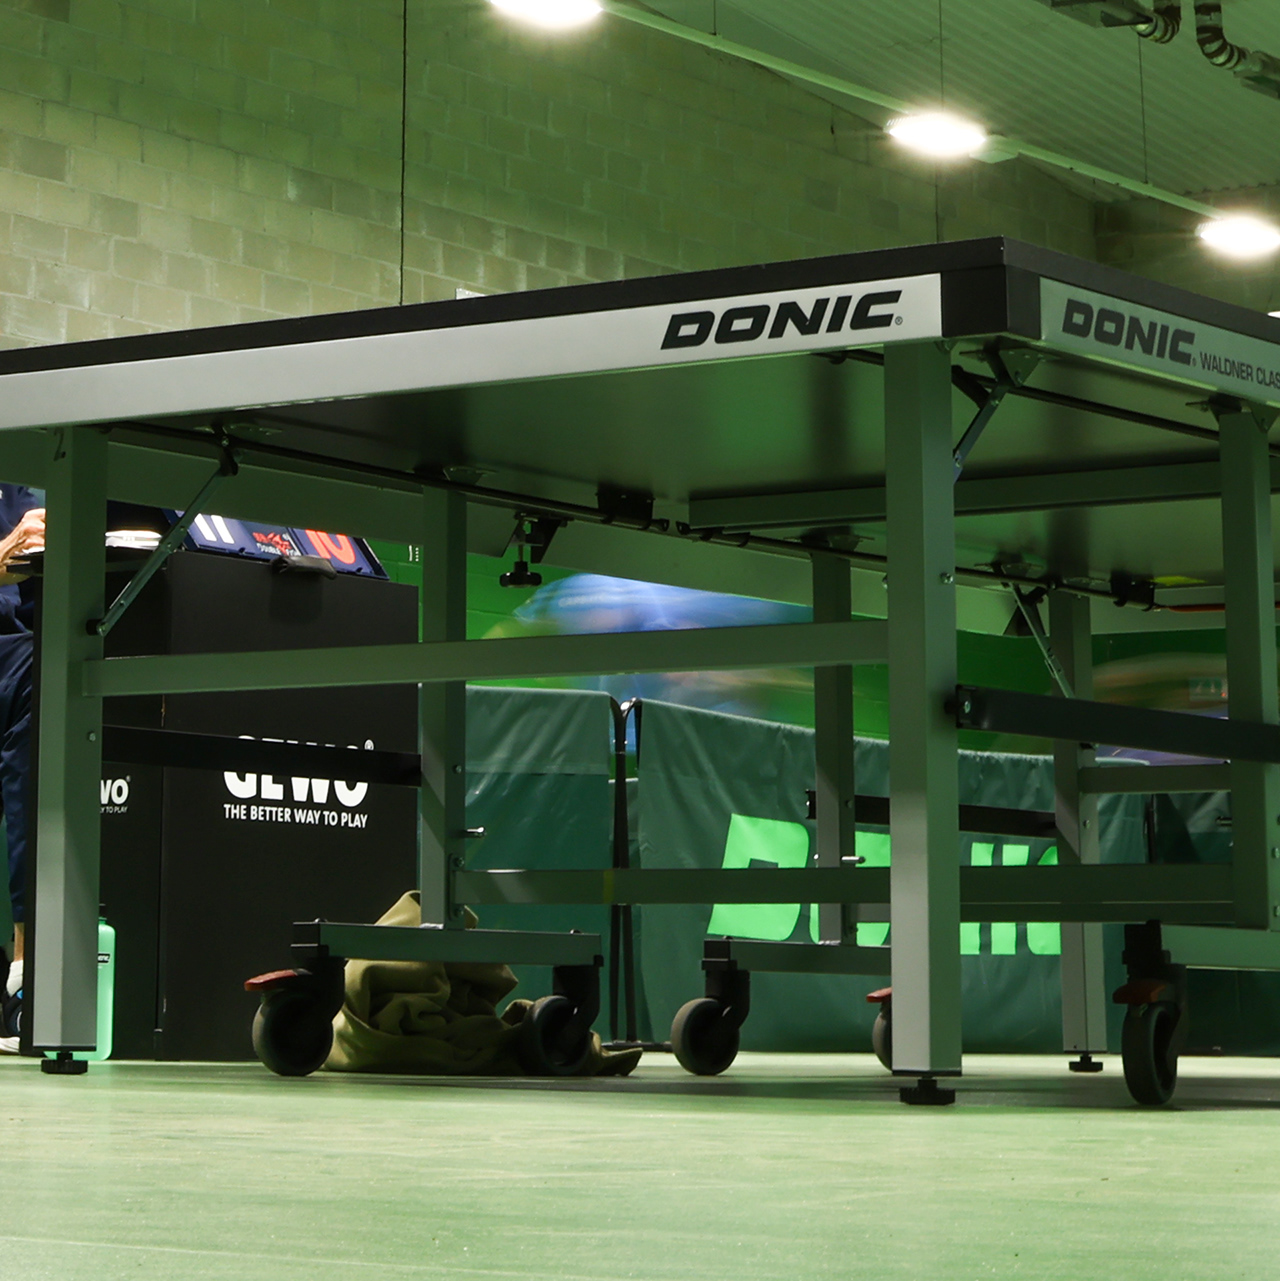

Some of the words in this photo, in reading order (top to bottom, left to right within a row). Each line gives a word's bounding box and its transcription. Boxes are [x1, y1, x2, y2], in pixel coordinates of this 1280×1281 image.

[660, 290, 903, 350] DONIC
[1061, 298, 1196, 366] DONIC
[1199, 351, 1253, 382] WALDNER
[223, 803, 246, 820] THE
[250, 805, 291, 822] BETTER
[294, 808, 320, 825] WAY
[323, 810, 338, 827] TO
[341, 812, 368, 829] PLAY
